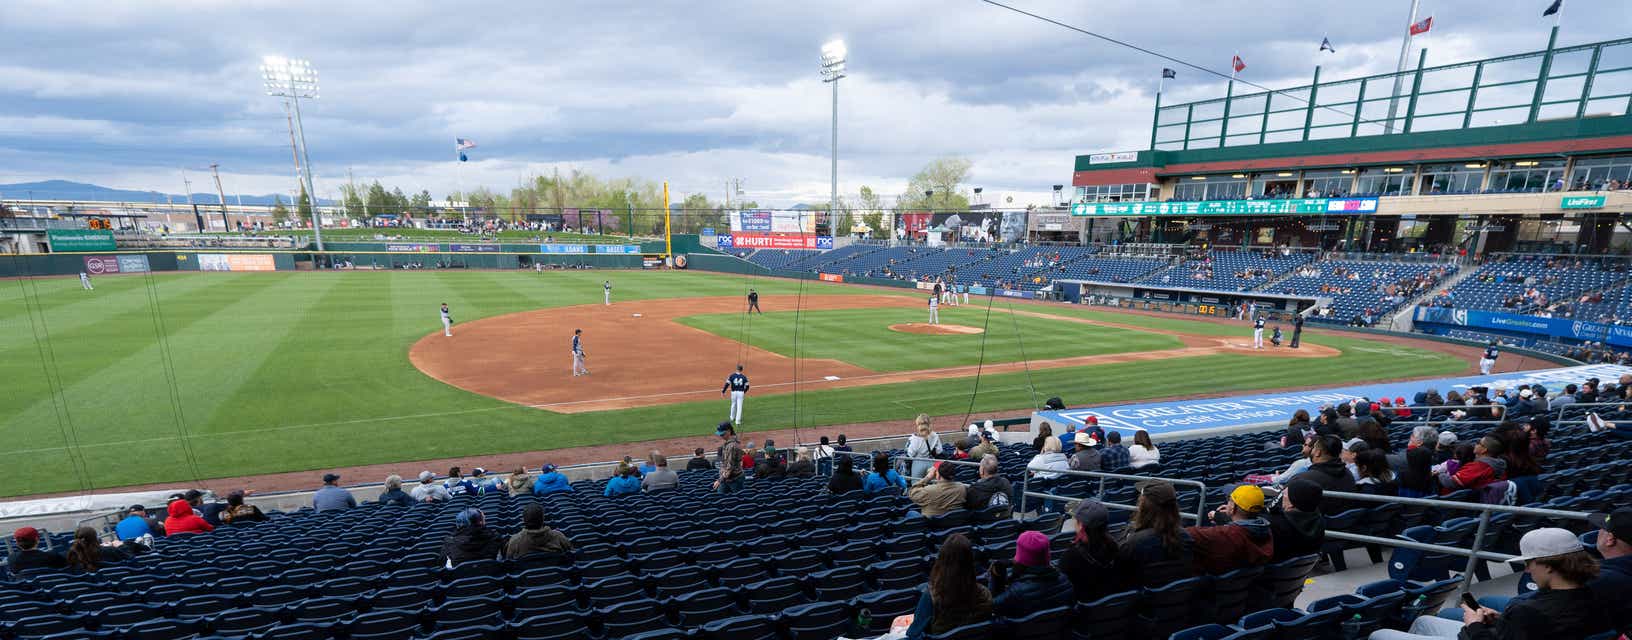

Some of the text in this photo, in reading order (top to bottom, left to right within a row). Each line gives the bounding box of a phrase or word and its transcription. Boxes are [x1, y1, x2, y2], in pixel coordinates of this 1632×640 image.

[1567, 198, 1598, 206] UniFirst
[1491, 317, 1548, 329] LiveGreater.com
[733, 377, 743, 386] 44
[1112, 402, 1256, 419] GREATER
[1143, 409, 1288, 427] Credit Union
